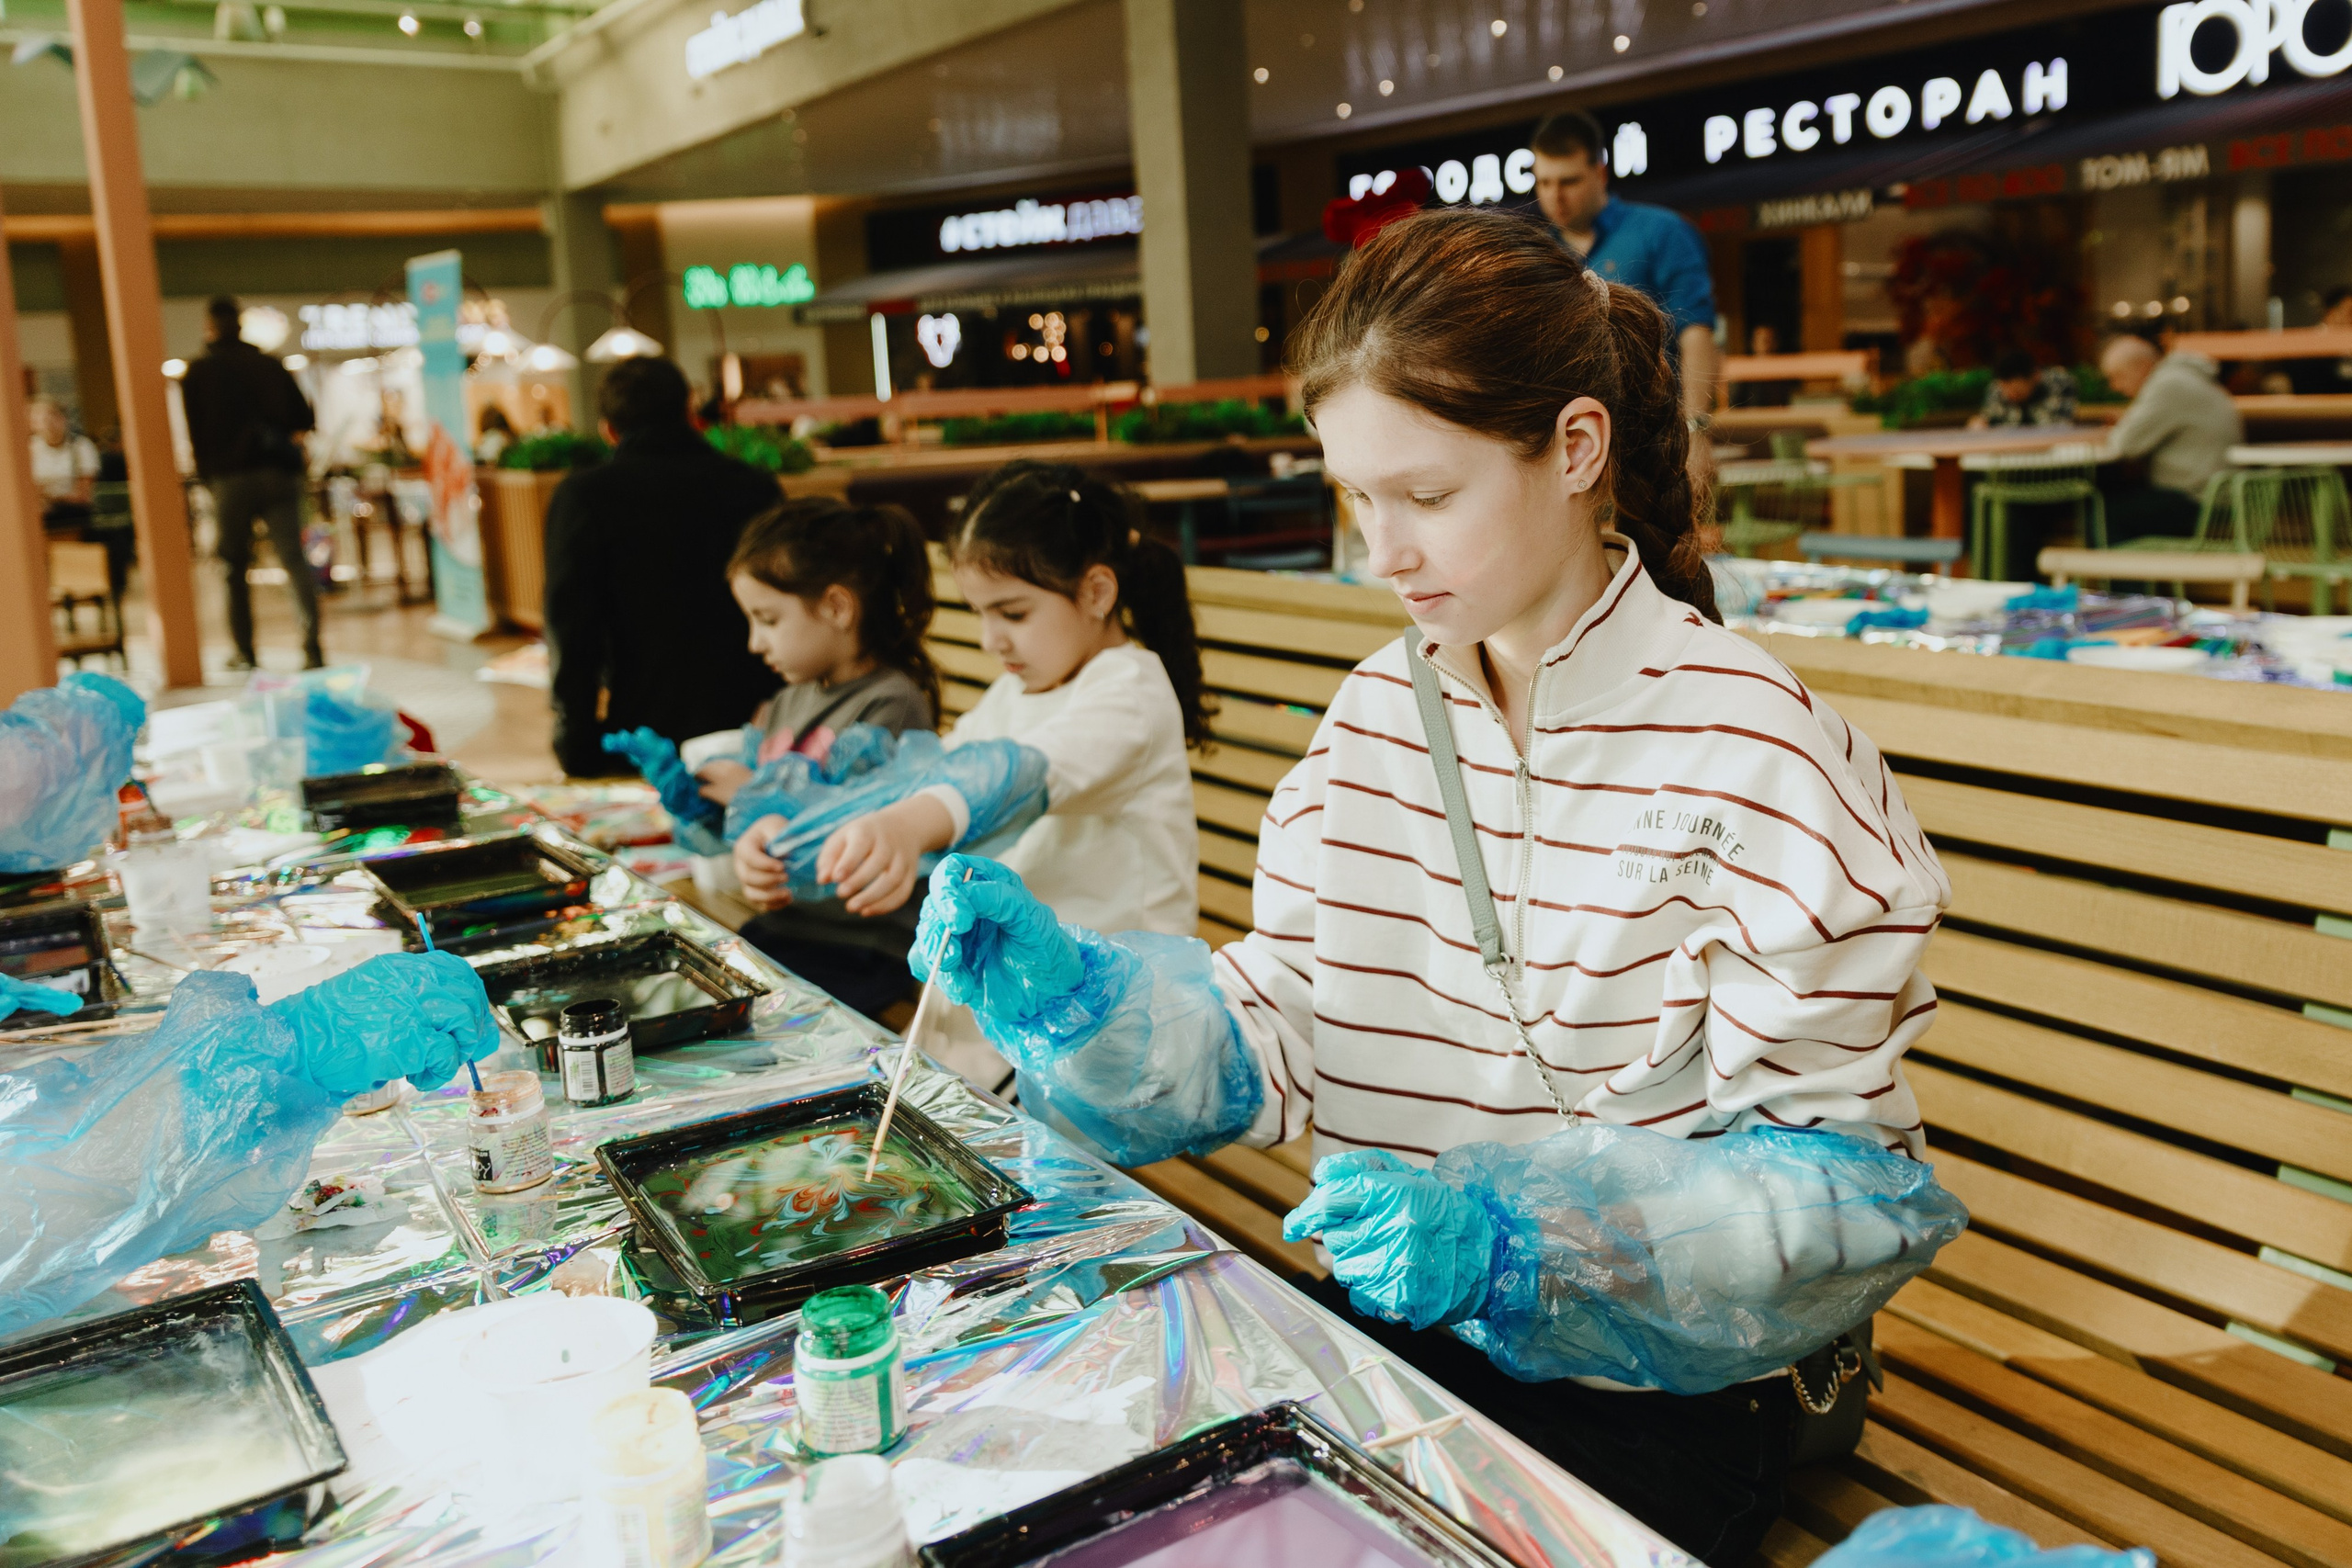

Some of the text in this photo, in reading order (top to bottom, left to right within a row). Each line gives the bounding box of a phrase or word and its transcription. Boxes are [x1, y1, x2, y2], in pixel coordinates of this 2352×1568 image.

[1349, 57, 2068, 205] ГОДСЙ РЕСТОРАН
[2080, 142, 2210, 191] ТОМ-ЯМ
[1671, 811, 1745, 862] JOURNÉE
[1617, 860, 1714, 886] SUR LA SEINE
